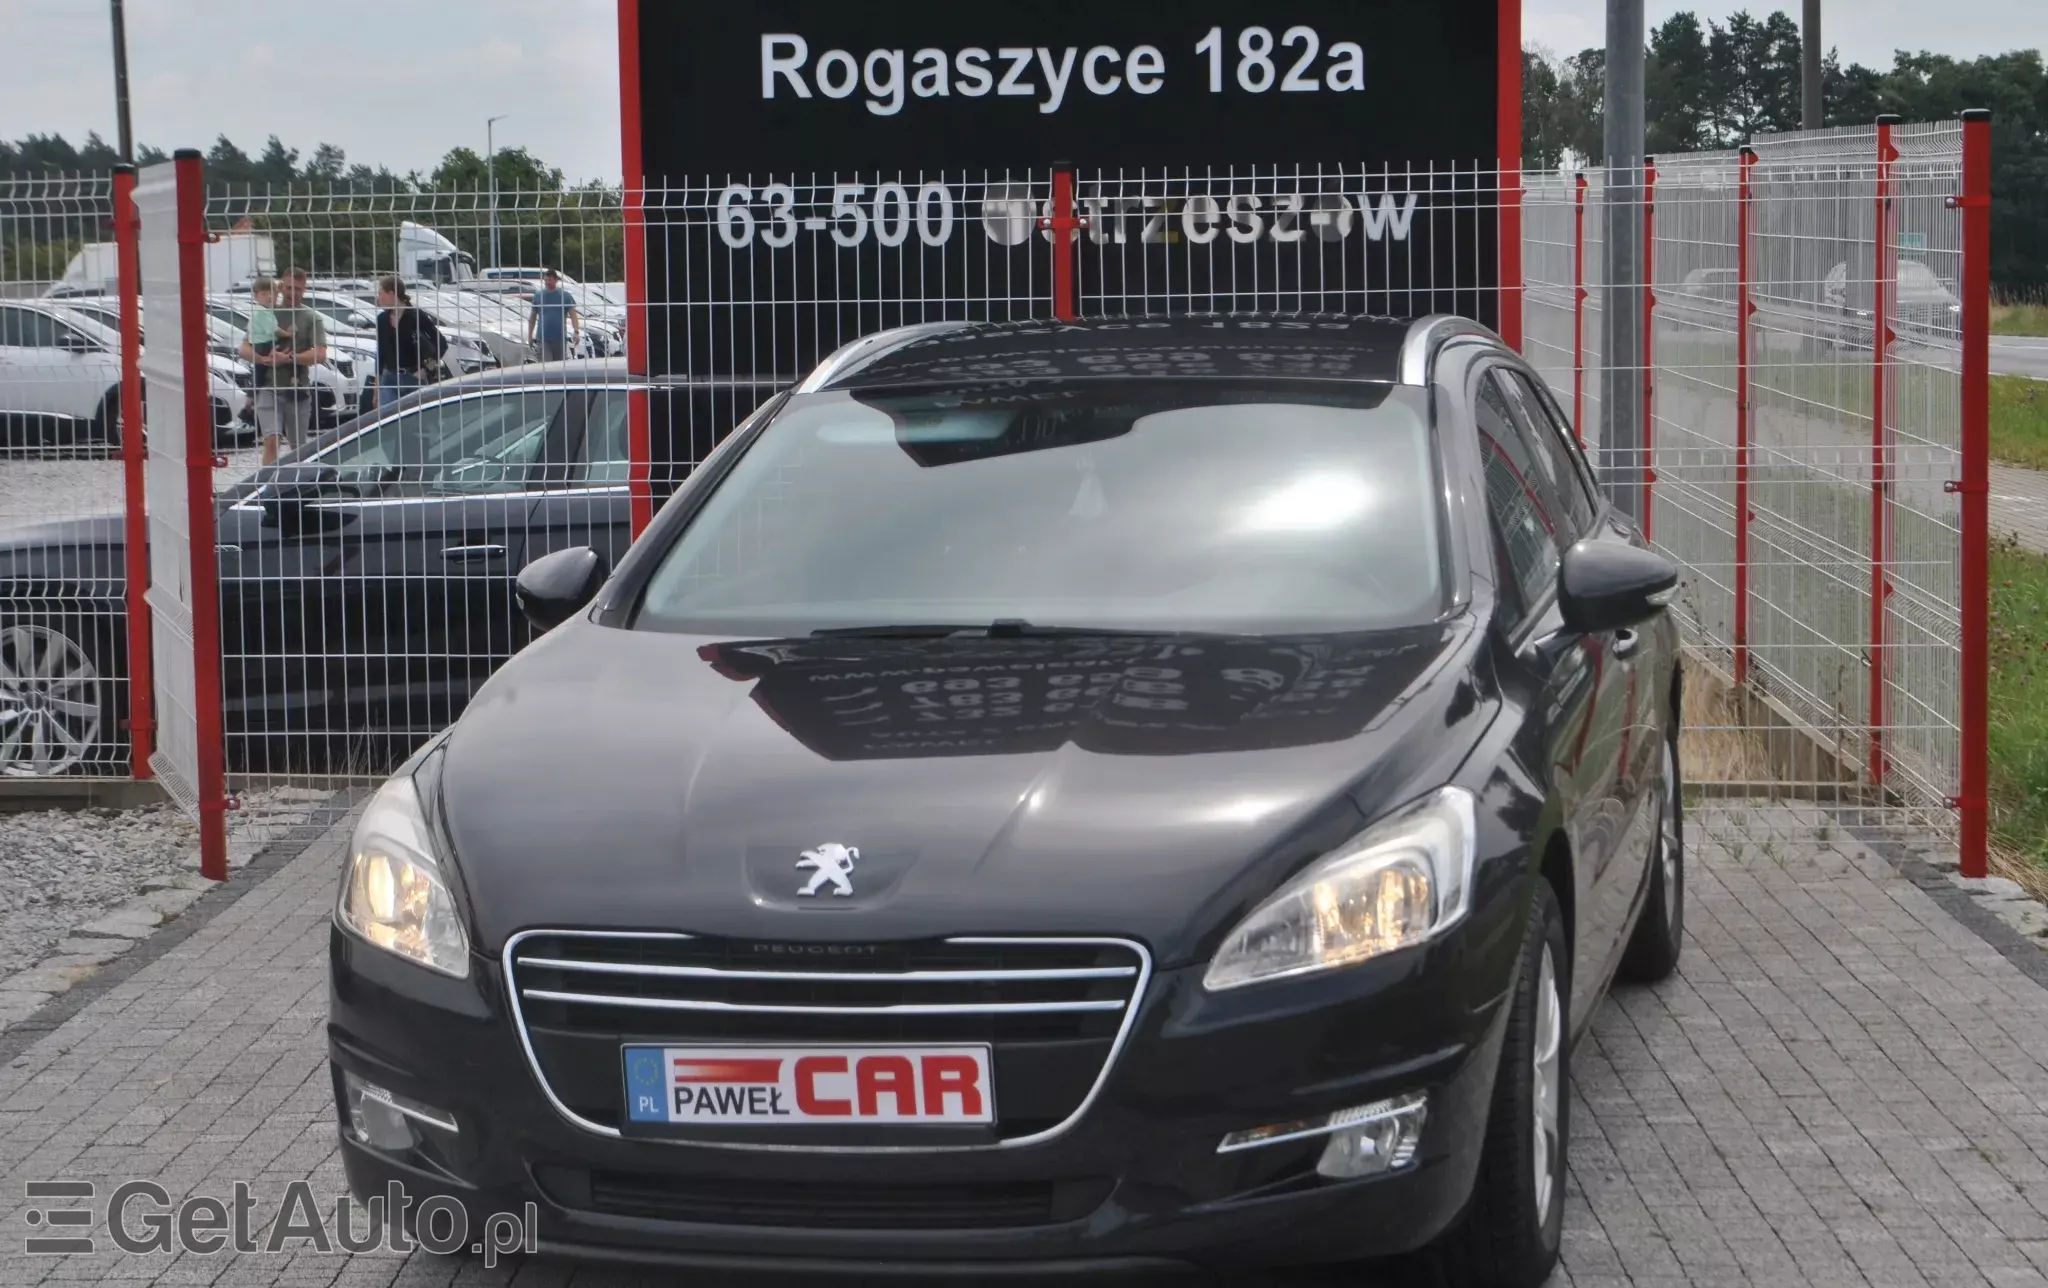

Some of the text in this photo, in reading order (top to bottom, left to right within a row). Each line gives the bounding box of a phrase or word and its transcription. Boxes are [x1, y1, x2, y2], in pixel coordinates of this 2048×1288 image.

[760, 25, 1366, 116] Rogaszyce 182a
[716, 181, 954, 249] 63-500
[753, 943, 877, 955] PEUGEOT
[638, 1096, 660, 1114] PL
[674, 1054, 983, 1116] PAWEŁ CAR
